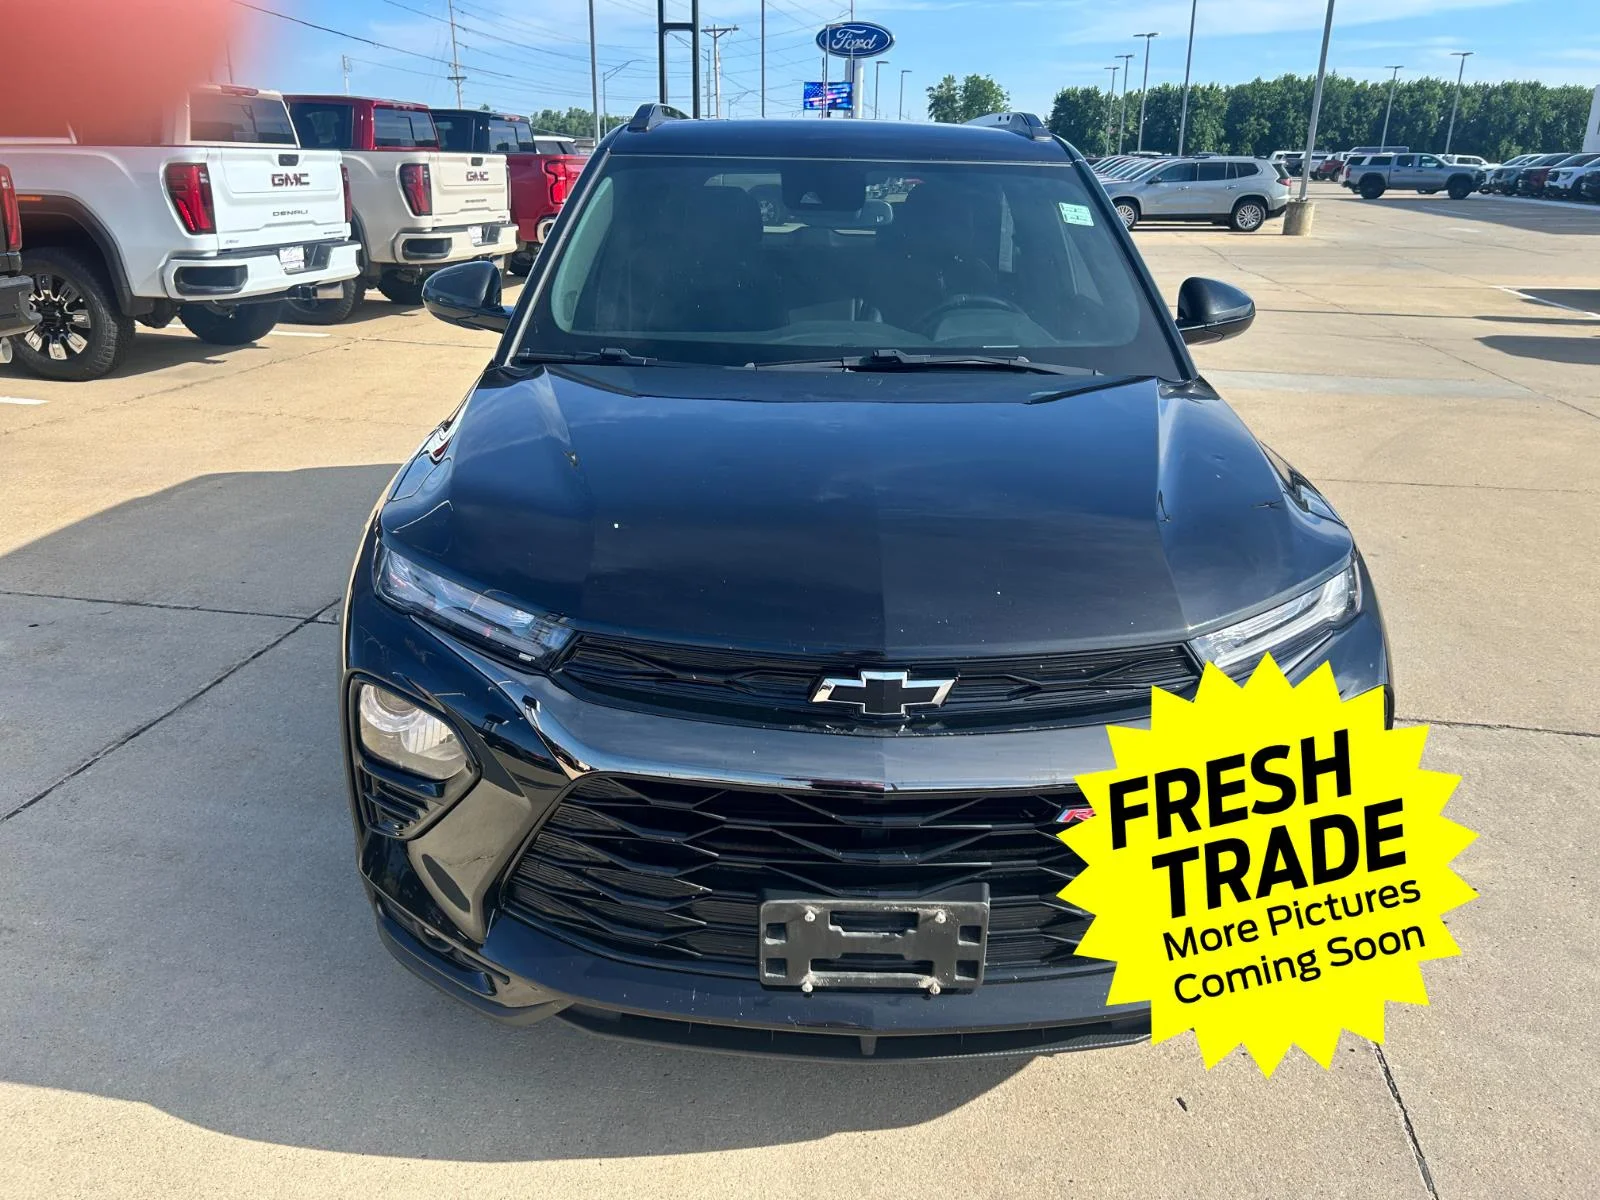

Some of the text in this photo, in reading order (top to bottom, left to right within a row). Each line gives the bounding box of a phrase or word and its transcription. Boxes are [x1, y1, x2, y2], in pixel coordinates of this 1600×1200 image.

[831, 28, 877, 50] Ford
[271, 173, 310, 187] GMC
[466, 171, 489, 182] GMC
[272, 209, 309, 217] DENALI
